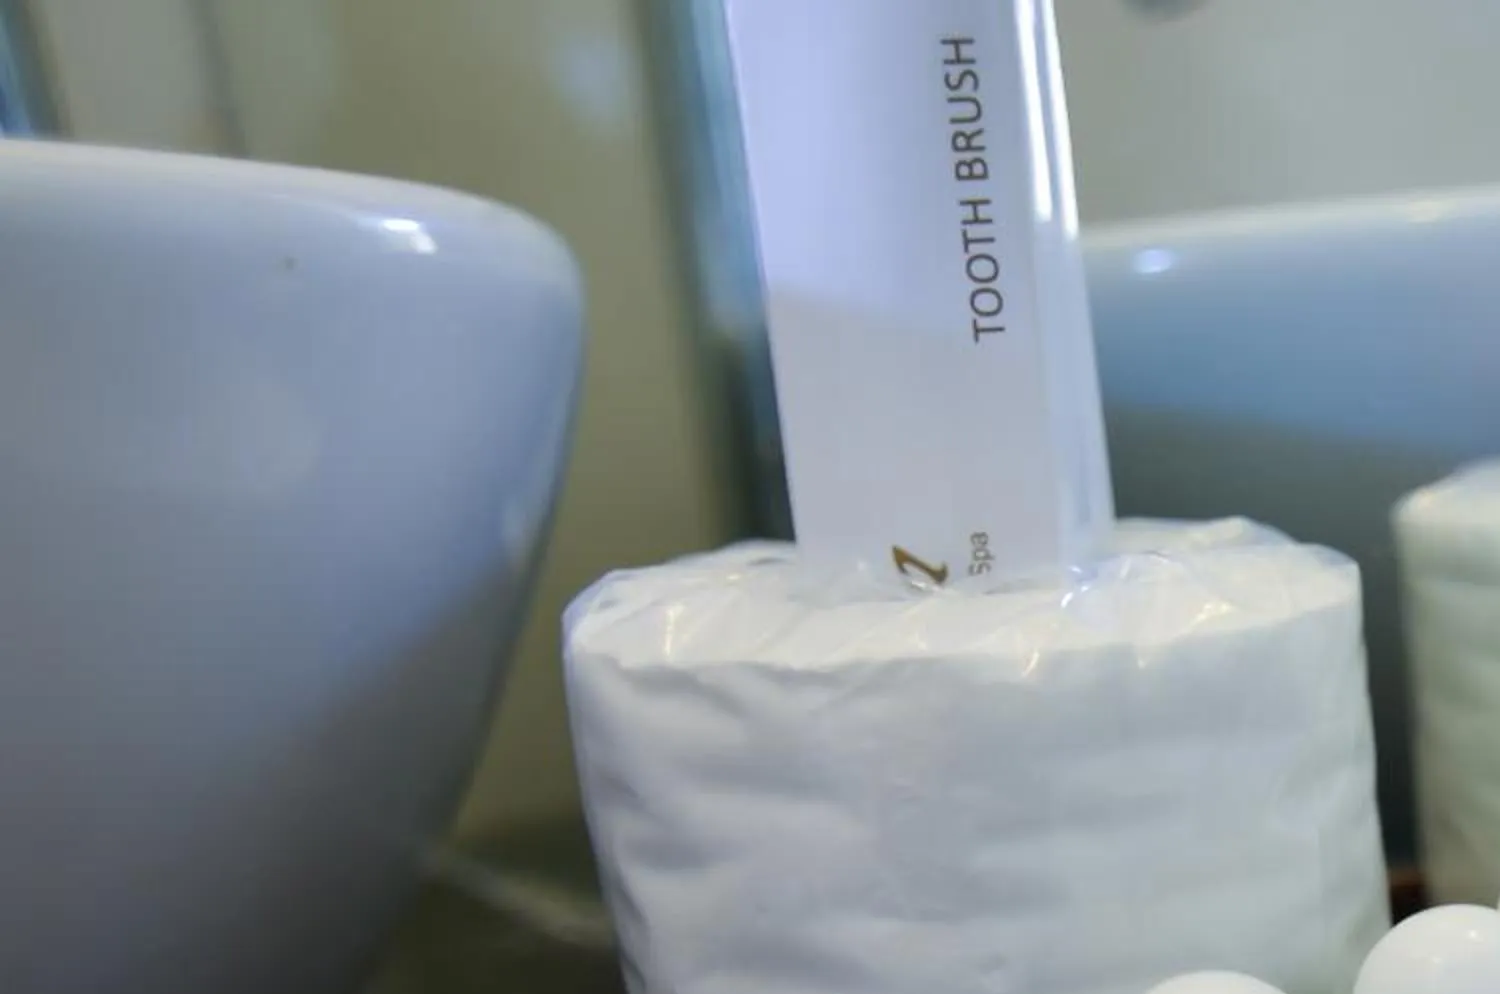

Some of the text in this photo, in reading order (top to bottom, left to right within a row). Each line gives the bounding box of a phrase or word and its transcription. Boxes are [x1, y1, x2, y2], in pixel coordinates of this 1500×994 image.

[940, 36, 1005, 343] TOOTH BRUSH
[968, 532, 993, 576] Spa
